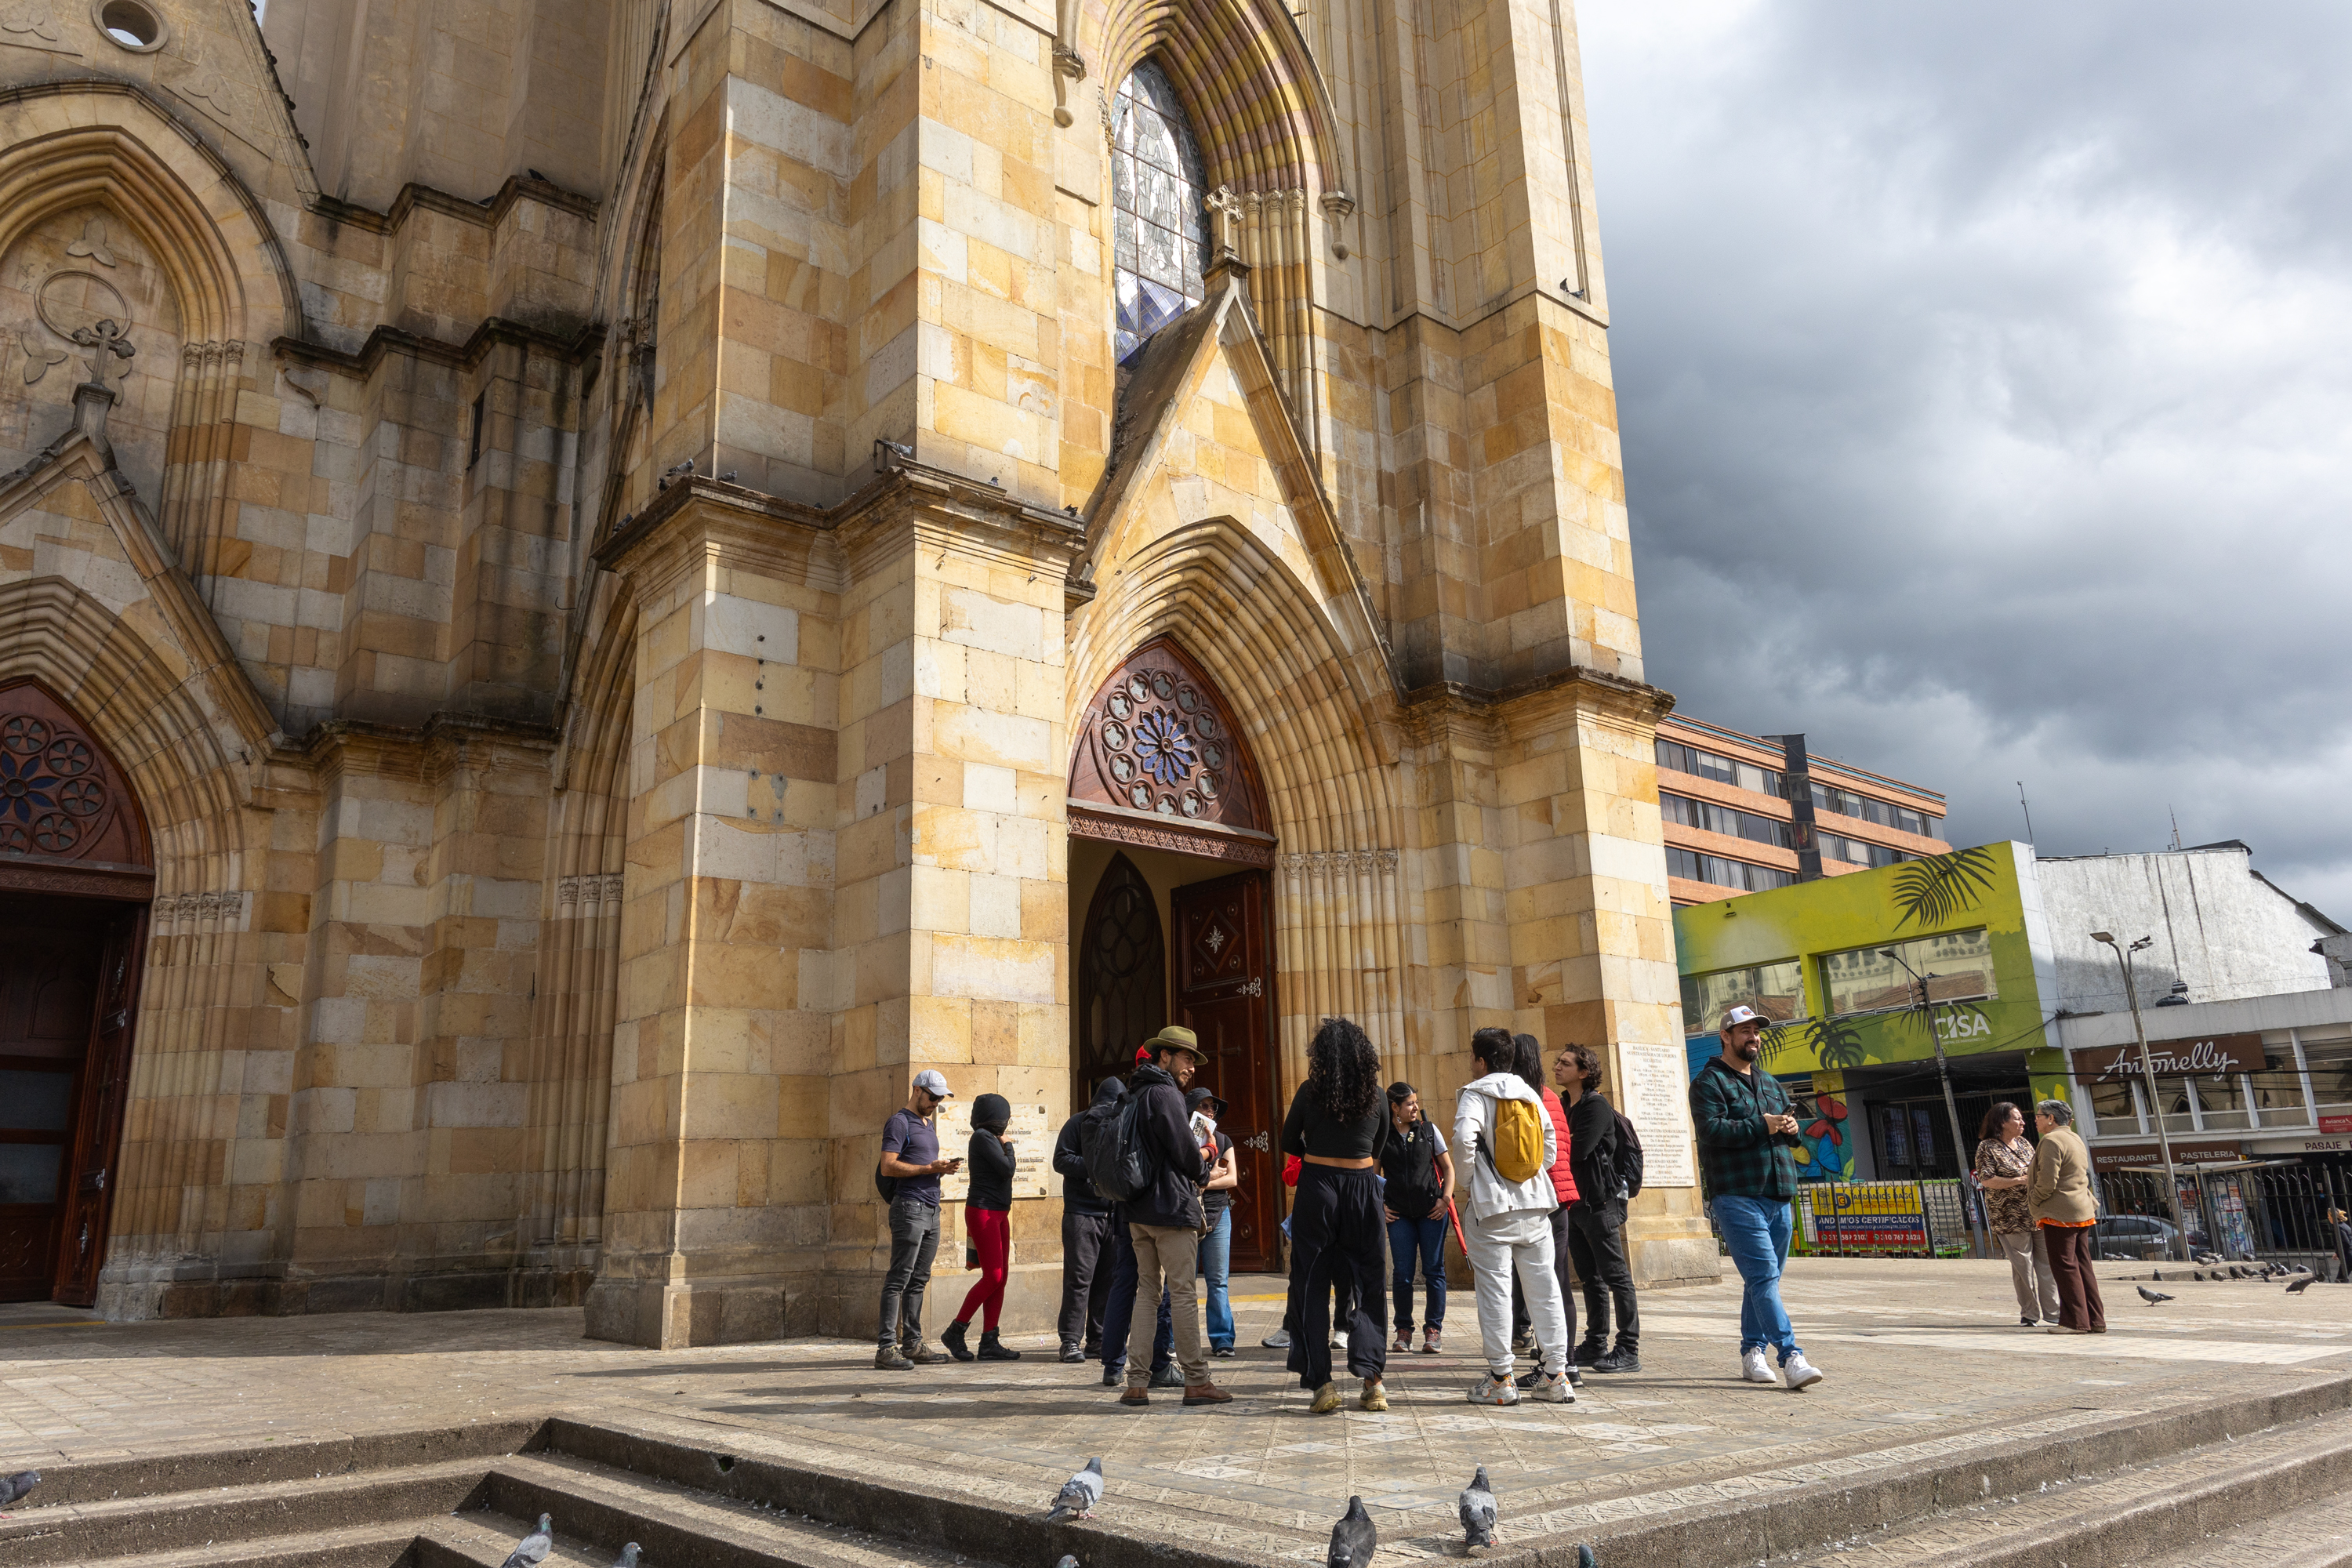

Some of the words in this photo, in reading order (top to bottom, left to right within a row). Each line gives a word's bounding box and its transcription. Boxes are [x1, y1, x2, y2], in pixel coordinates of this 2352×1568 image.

[2096, 1041, 2239, 1082] Antonelly
[2305, 1141, 2342, 1151] PASAJE
[2096, 1154, 2158, 1163] RESTAURANTE
[2180, 1151, 2236, 1160] PASTELERIA
